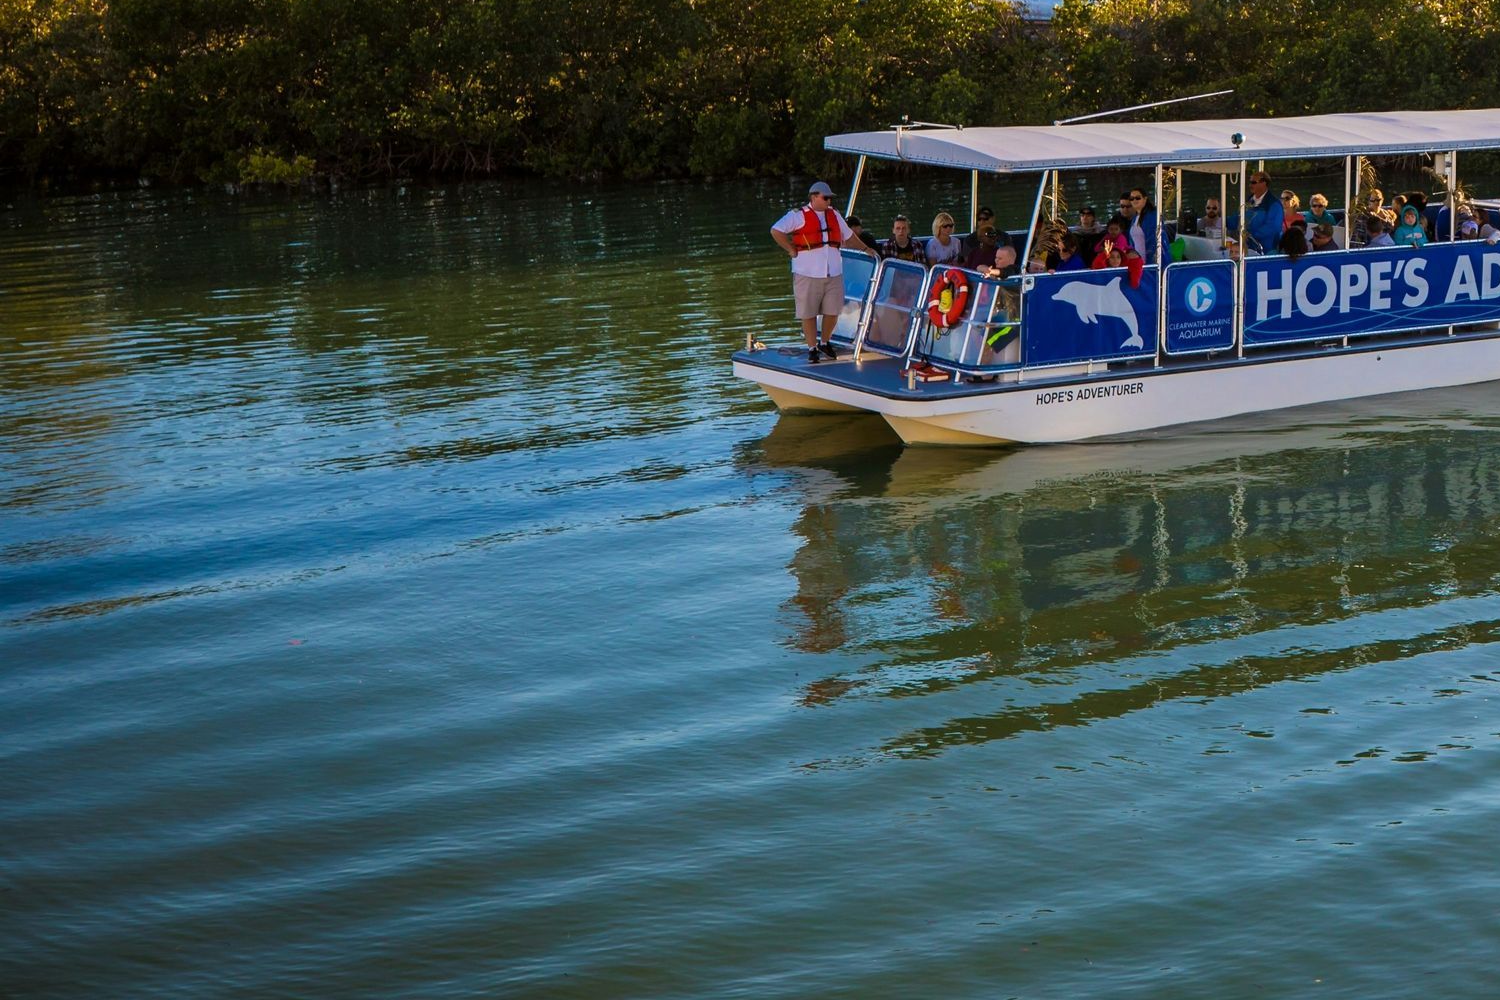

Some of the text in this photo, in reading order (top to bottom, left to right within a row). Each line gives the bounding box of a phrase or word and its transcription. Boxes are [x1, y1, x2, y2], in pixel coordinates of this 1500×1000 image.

[1256, 257, 1429, 320] HOPE’S
[1169, 317, 1231, 331] CLEARWATER MARINE
[1178, 327, 1221, 339] AQUARIUM
[1036, 382, 1144, 405] HOPE'S ADVENTURER
